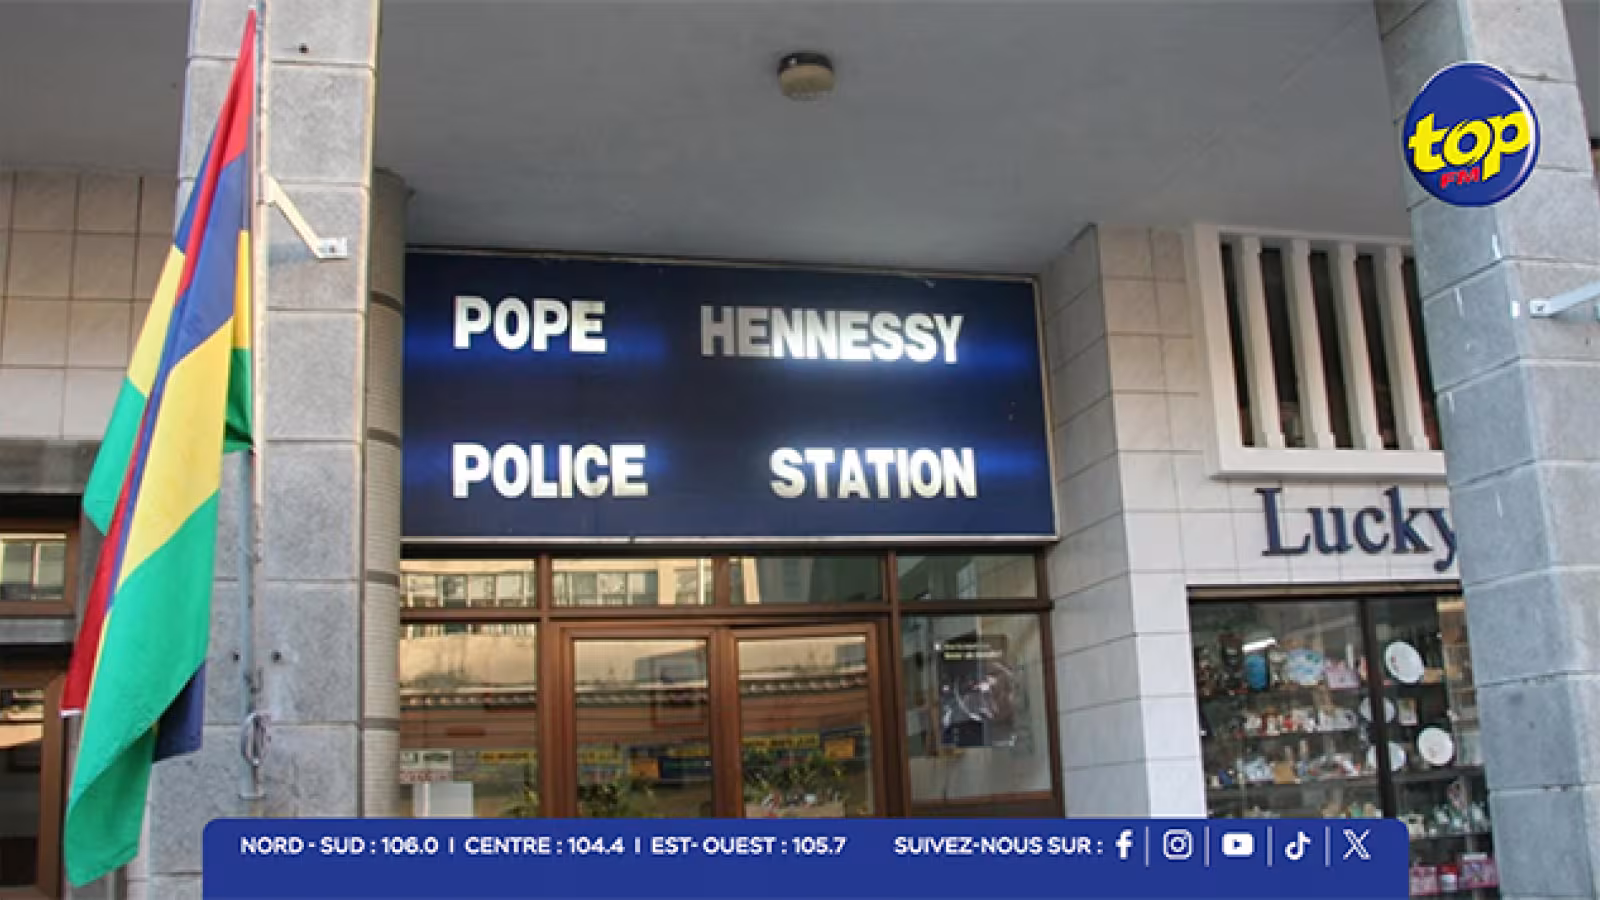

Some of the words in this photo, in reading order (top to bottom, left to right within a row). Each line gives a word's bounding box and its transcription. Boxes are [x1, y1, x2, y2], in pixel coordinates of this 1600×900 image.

[453, 295, 608, 352] POPE
[700, 305, 964, 364] HENNESSY
[452, 442, 649, 499] POLICE
[769, 447, 978, 499] STATION
[1254, 484, 1458, 572] Lucky
